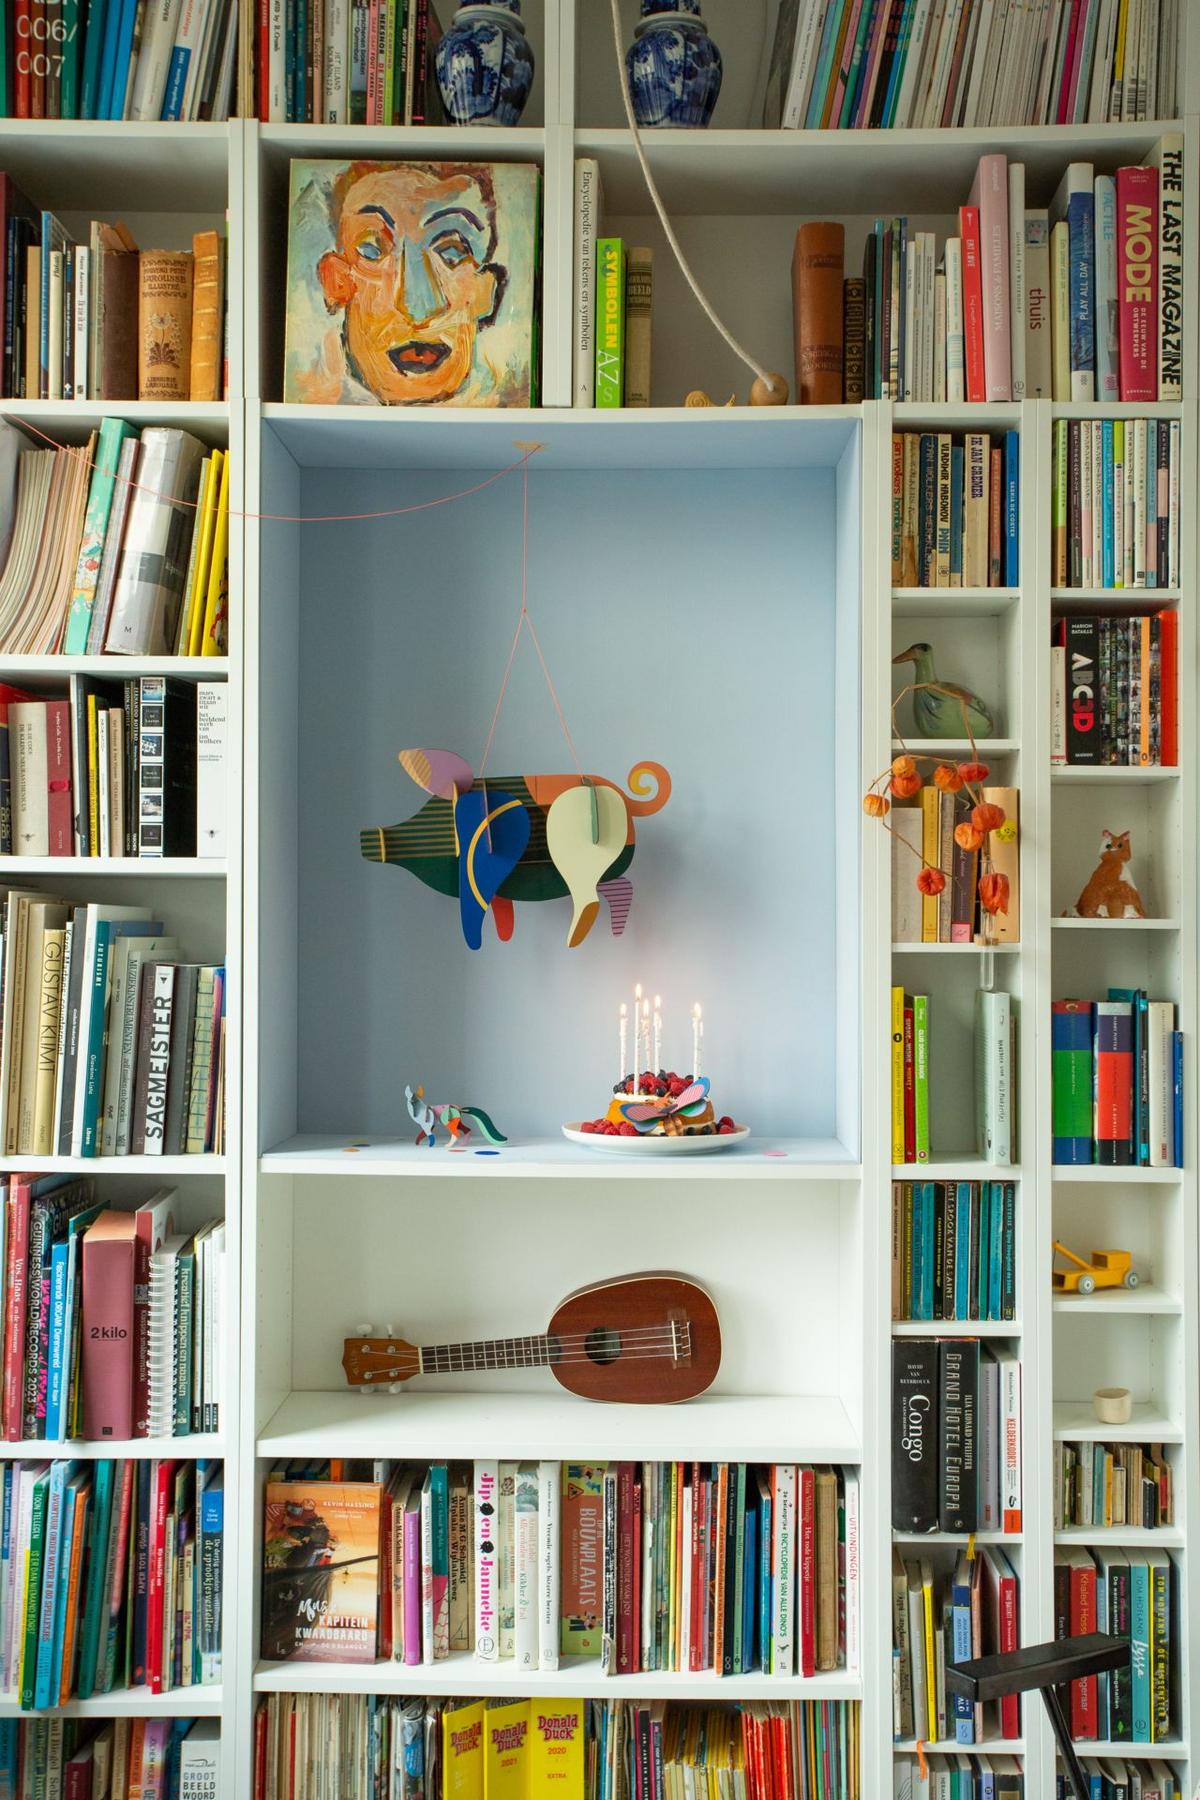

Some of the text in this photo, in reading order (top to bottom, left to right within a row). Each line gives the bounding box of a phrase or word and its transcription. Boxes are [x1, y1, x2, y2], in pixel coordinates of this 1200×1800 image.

[16, 15, 77, 42] 006/
[16, 51, 65, 77] 007
[1103, 191, 1114, 241] TACTILE
[579, 171, 592, 351] Encyclopedie van tekens en symbolen
[1125, 204, 1152, 304] MODE
[1161, 151, 1182, 385] THE LAST MAGAZINE
[605, 250, 618, 348] SYMBOLEN
[1078, 261, 1089, 320] PLAY ALL DAY
[1029, 288, 1046, 330] thuis
[1140, 307, 1146, 317] DE
[1140, 360, 1147, 369] DE
[971, 447, 982, 463] JAN
[971, 466, 983, 498] CREMER
[891, 442, 903, 561] jan wolkers tango
[938, 443, 950, 554] VLADIMIR NABOKOV PNIN
[1010, 504, 1015, 512] DE
[1072, 652, 1094, 732] ABC3D
[95, 943, 104, 987] FUTURISME
[39, 942, 61, 1074] GUSTAV KLIMT
[122, 960, 138, 1054] MUZIEKINSTRUMENTEN
[146, 996, 172, 1139] SAGMEISTER
[946, 1237, 954, 1256] VAN
[946, 1259, 953, 1268] DE
[54, 1261, 64, 1300] Fascinerende
[179, 1268, 191, 1307] kreatief
[26, 1221, 43, 1403] GUINNESS WORLD RECORDS 2023
[90, 1327, 128, 1339] 2kilo
[176, 1308, 189, 1349] knippen
[52, 1328, 62, 1368] Dierenwereld
[902, 1394, 930, 1461] Congo
[946, 1353, 962, 1511] GRAND HOTEL EUROPA
[964, 1410, 972, 1437] LEONARD
[1007, 1418, 1017, 1468] KELDERKOORTS
[33, 1494, 42, 1511] TOON
[50, 1493, 59, 1529] AVONTUUR
[450, 1496, 458, 1531] Wiplala
[49, 1532, 58, 1554] ONDER
[214, 1539, 220, 1547] De
[804, 1527, 812, 1539] Het
[212, 1549, 220, 1566] dertig
[450, 1541, 458, 1577] Wiplala
[478, 1472, 494, 1631] Jip en Janneke
[579, 1508, 597, 1606] BOUWPLAATS
[780, 1533, 789, 1580] ENCYCLOPEDIE
[849, 1517, 857, 1580] UITVINDINGEN
[29, 1568, 38, 1580] DAN
[47, 1556, 56, 1579] WATER
[803, 1557, 811, 1582] kippetje
[1113, 1576, 1118, 1585] De
[28, 1582, 37, 1612] NIEMAND
[47, 1581, 55, 1589] IN
[204, 1540, 212, 1632] de sprookjesverteller
[519, 1573, 528, 1597] Kikker
[780, 1582, 788, 1596] VAN
[1080, 1574, 1088, 1605] Khaled
[1157, 1576, 1165, 1634] TOM HOFLAND
[319, 1615, 368, 1628] KAPITEIN
[1157, 1649, 1165, 1658] DE
[450, 1720, 482, 1746] Donald
[491, 1720, 529, 1743] Donald
[537, 1713, 579, 1729] Donald
[542, 1727, 575, 1742] Duck
[454, 1739, 480, 1758] Duck
[495, 1738, 525, 1754] Duck
[547, 1746, 567, 1755] 2020
[183, 1772, 215, 1780] GROOT
[183, 1782, 216, 1790] BEELD
[182, 1792, 215, 1800] WOORD
